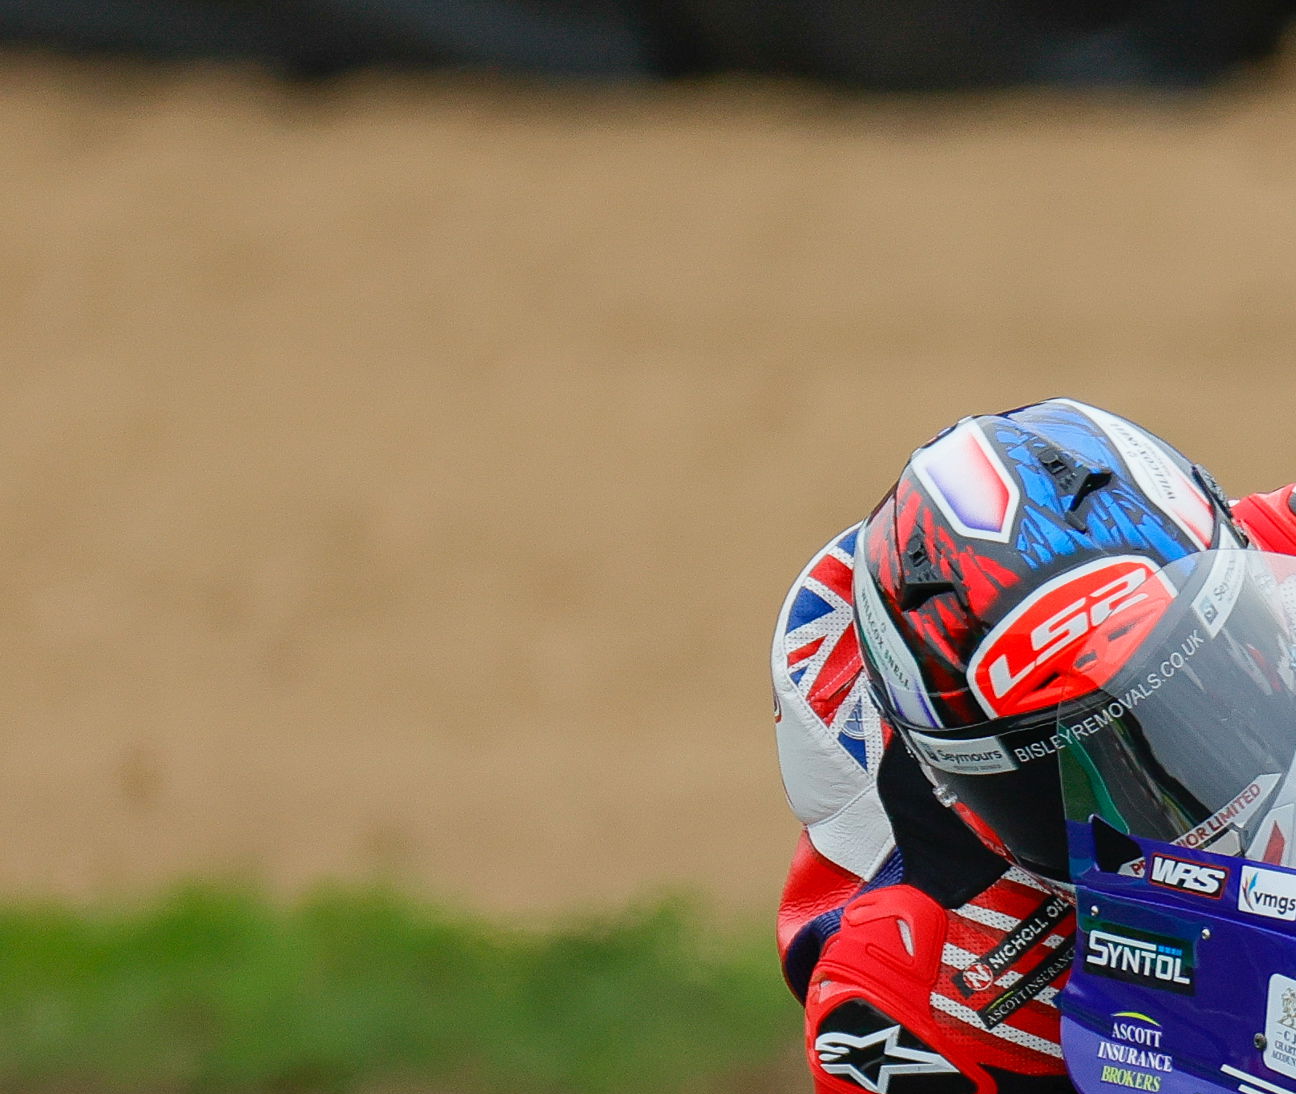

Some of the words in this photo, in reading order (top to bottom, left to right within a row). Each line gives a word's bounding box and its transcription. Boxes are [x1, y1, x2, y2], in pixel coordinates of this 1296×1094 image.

[988, 567, 1149, 699] LS2
[1014, 629, 1205, 764] BISLEYREMOVALS.CO.UK
[1207, 783, 1262, 831] LIMITED
[1152, 856, 1226, 894] WRS
[1253, 890, 1296, 915] vmgs
[988, 917, 1049, 969] NICHOLL
[1086, 929, 1191, 986] SYNTOL
[1111, 1022, 1163, 1048] ASCOTT
[1097, 1041, 1173, 1073] INSURANCE
[1100, 1065, 1161, 1093] BROKERS
